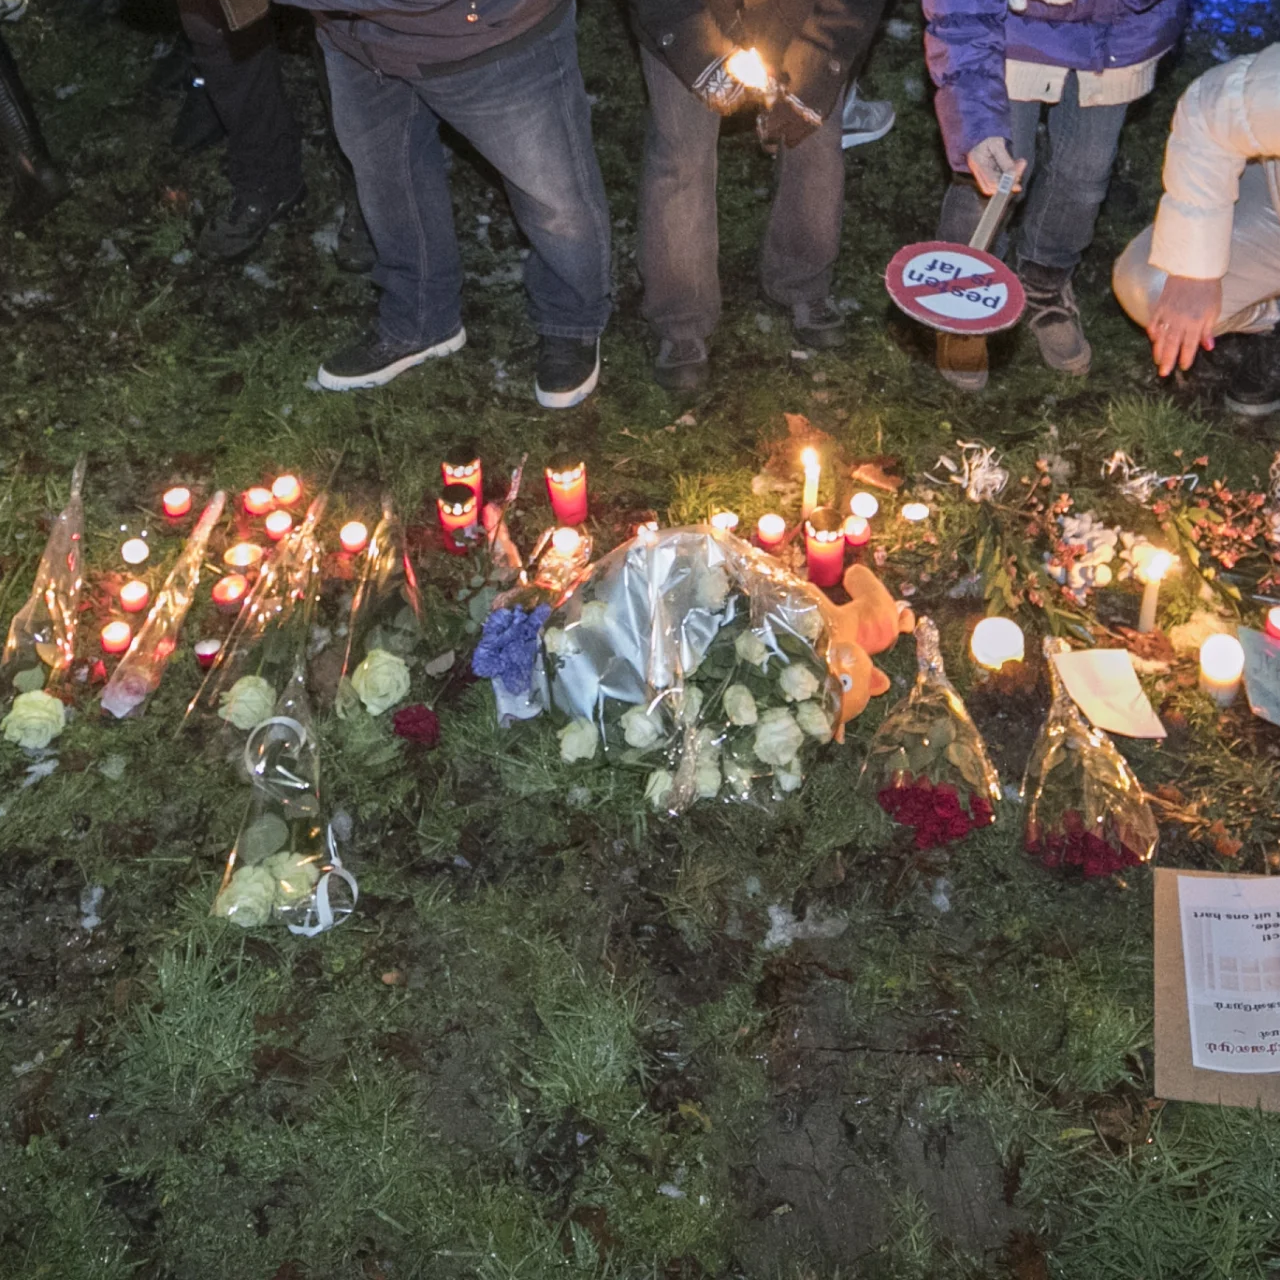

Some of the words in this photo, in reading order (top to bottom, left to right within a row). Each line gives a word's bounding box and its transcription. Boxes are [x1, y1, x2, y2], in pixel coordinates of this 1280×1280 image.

[924, 259, 962, 279] laf
[908, 269, 1001, 309] pesten
[971, 273, 992, 291] is
[1193, 911, 1221, 920] hart
[1254, 912, 1271, 921] uit
